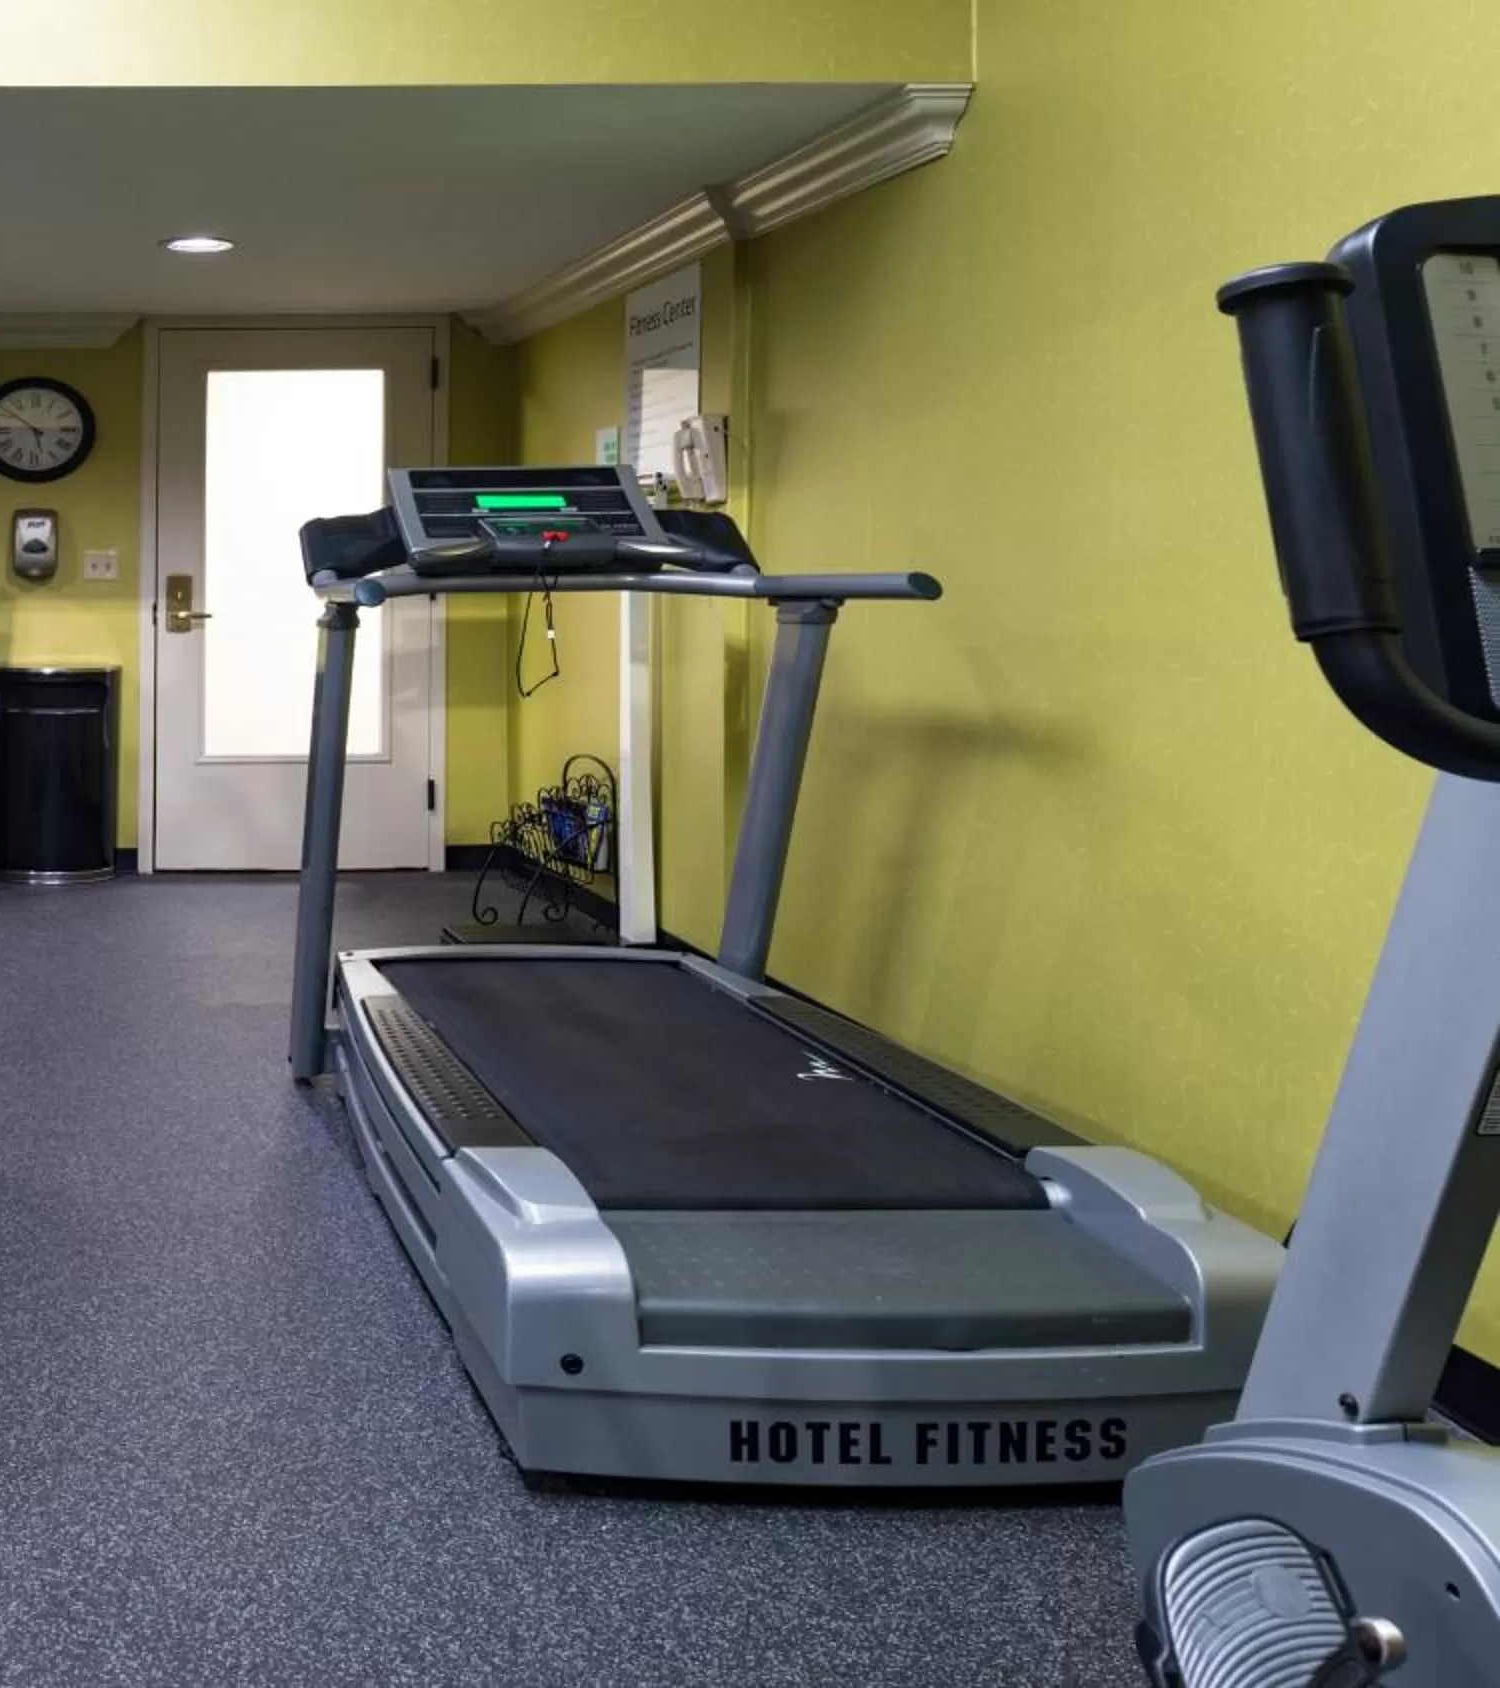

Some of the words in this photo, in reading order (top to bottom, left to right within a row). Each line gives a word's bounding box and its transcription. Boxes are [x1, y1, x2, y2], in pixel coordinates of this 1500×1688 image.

[629, 310, 662, 337] Fitness
[663, 295, 697, 326] Center
[729, 1420, 892, 1465] HOTEL
[916, 1418, 1128, 1465] FITNESS
